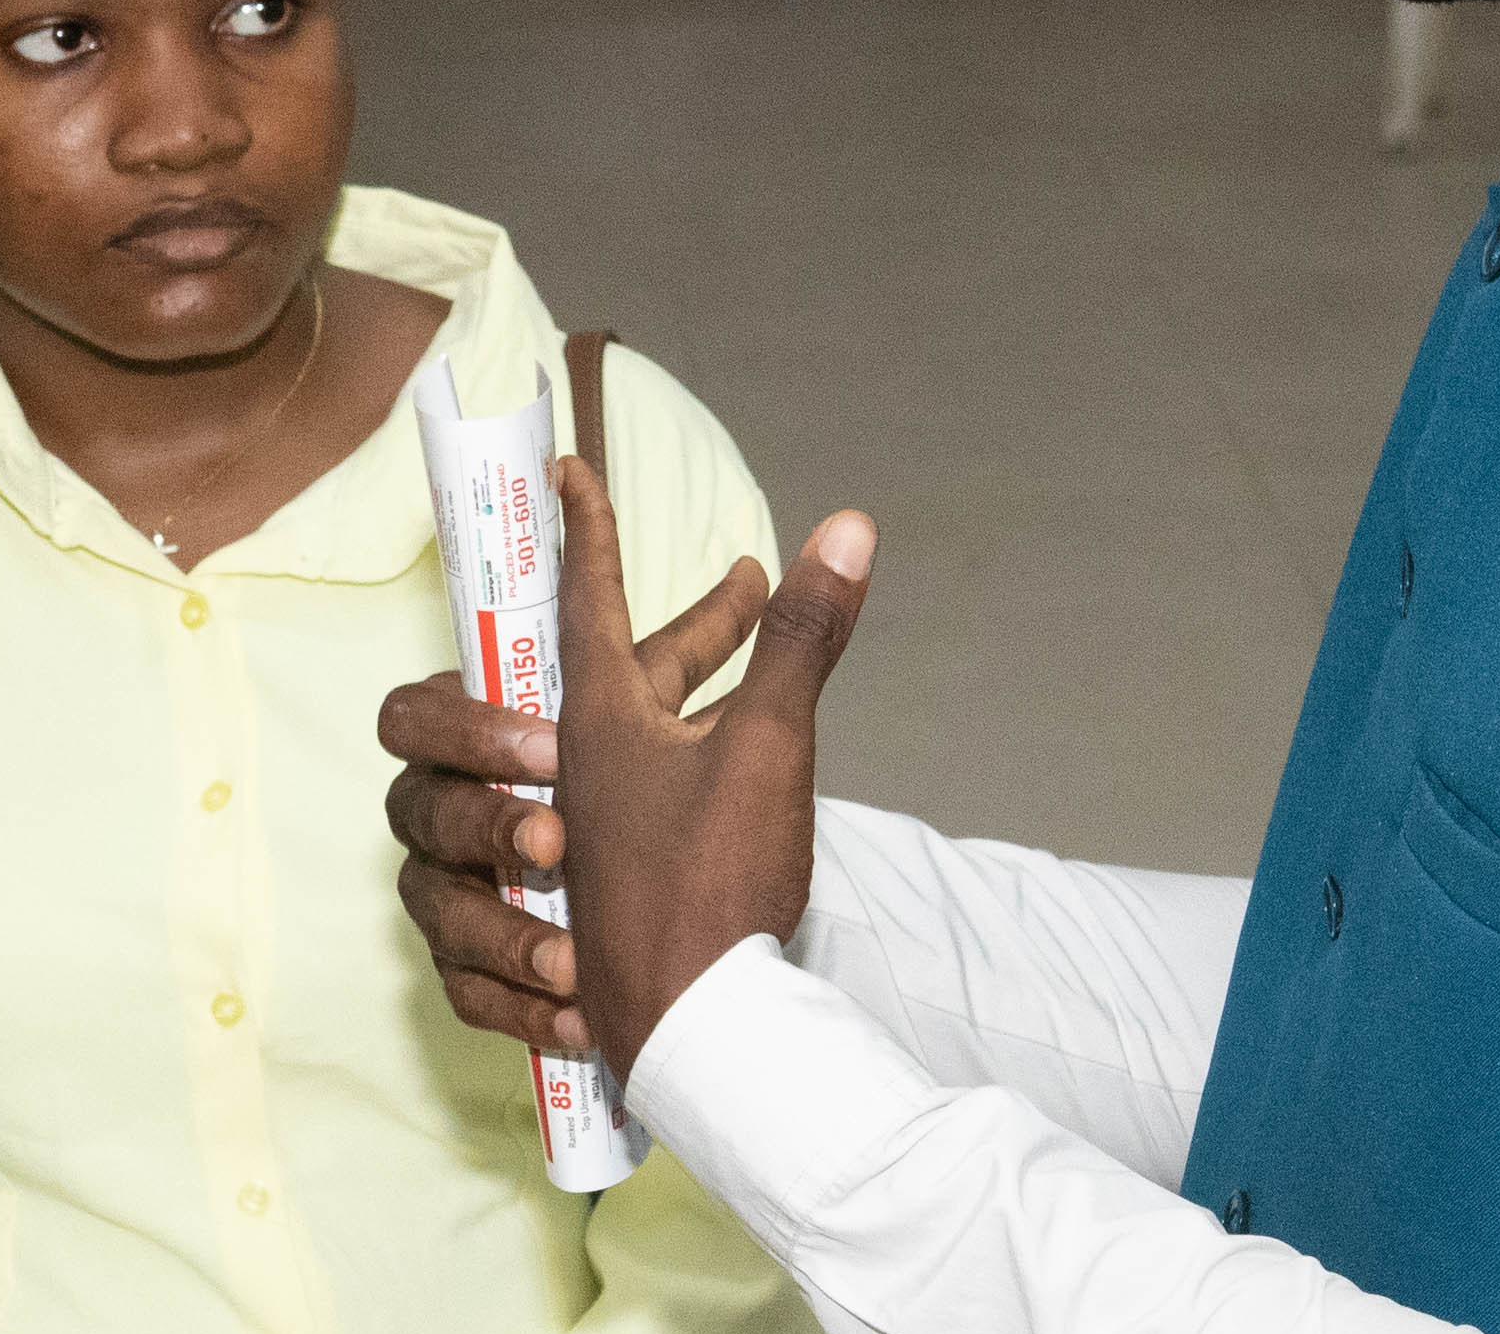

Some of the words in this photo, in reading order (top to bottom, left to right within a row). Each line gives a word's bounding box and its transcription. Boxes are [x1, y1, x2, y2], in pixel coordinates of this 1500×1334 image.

[496, 463, 507, 496] BAND
[501, 501, 511, 533] RANK
[530, 499, 541, 549] GLOBALLY
[504, 537, 512, 548] IN
[506, 552, 517, 598] PLACED
[535, 619, 542, 628] in
[537, 630, 547, 667] Colleges
[503, 662, 513, 684] Band
[511, 638, 541, 715] 01-150
[549, 663, 558, 691] INDIA
[541, 668, 554, 718] ngineering
[591, 1074, 601, 1103] INDIA
[566, 1116, 577, 1148] Ranked
[582, 1116, 591, 1132] Top
